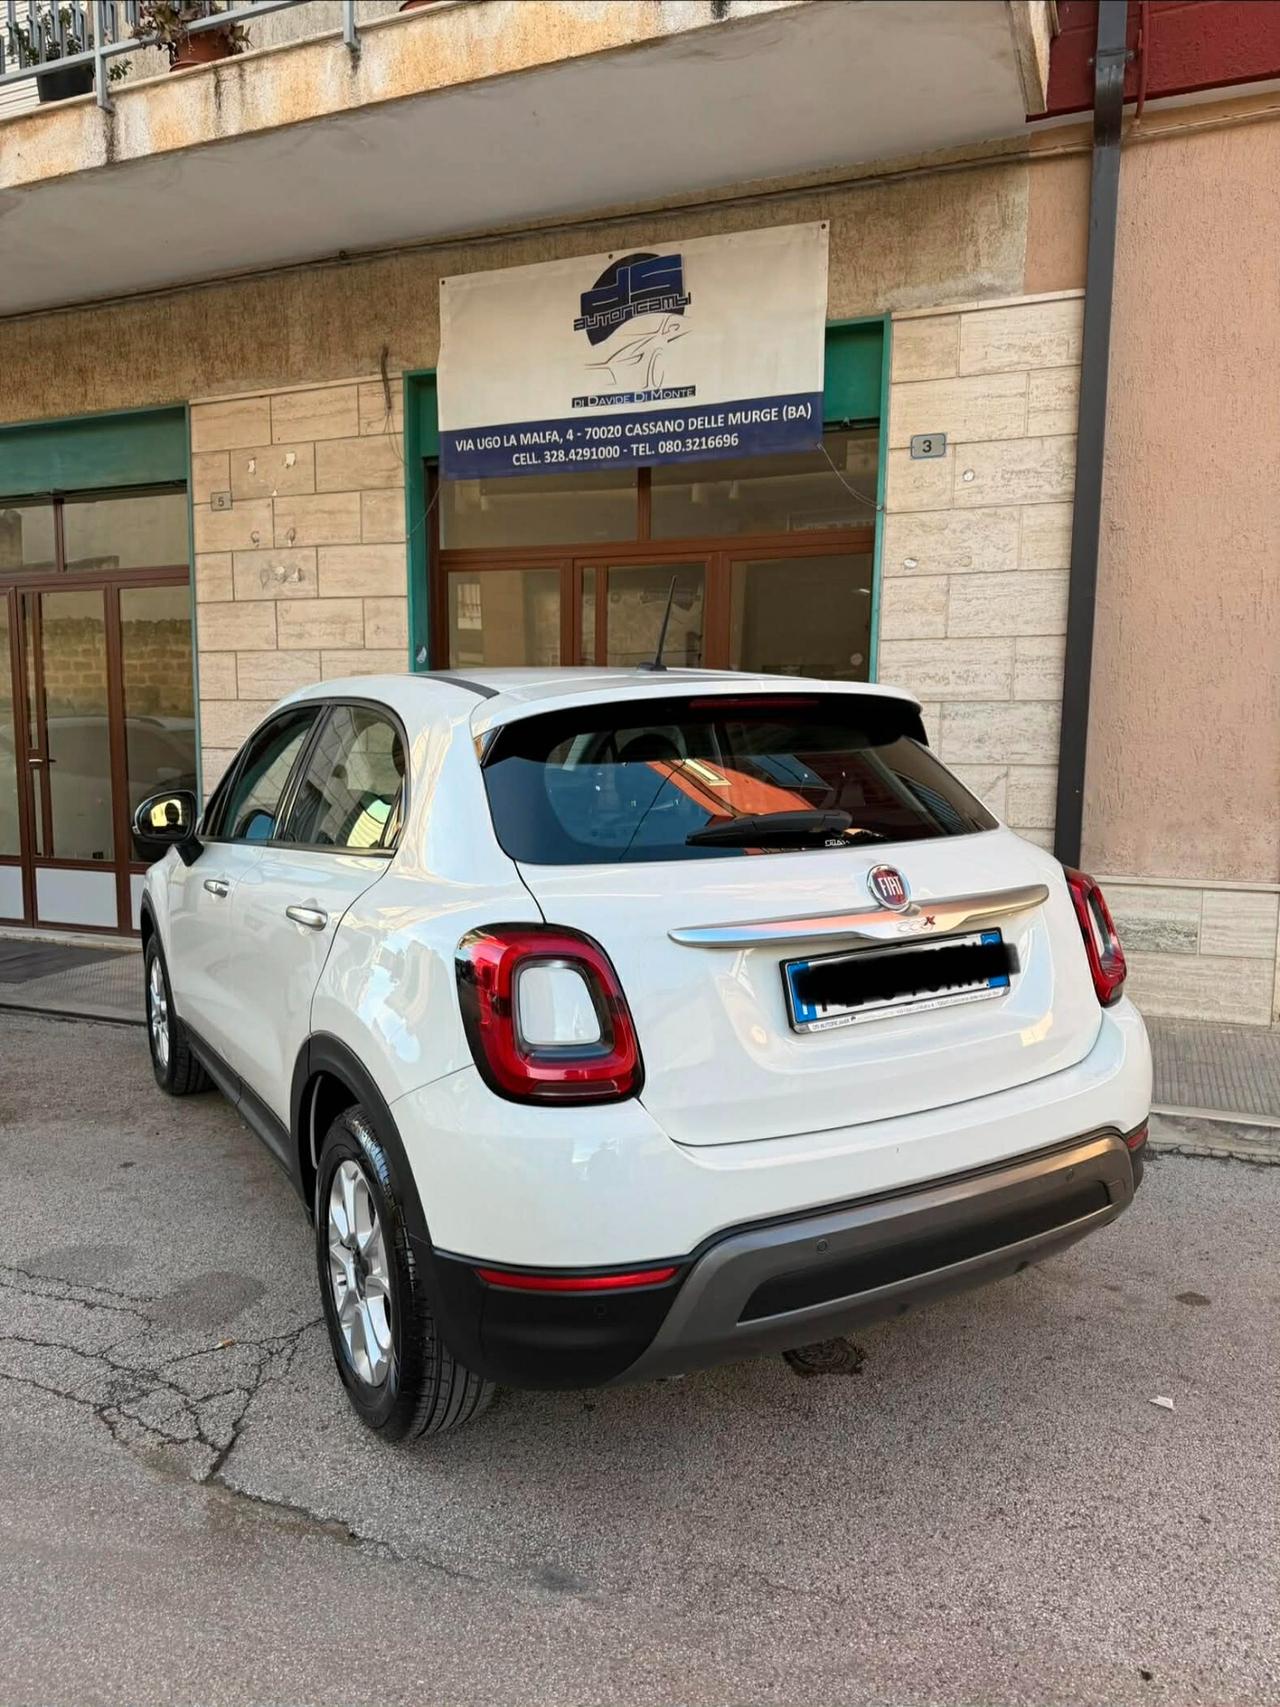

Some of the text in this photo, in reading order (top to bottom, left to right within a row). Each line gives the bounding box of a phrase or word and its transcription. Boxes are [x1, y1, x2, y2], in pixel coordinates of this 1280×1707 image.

[650, 385, 695, 402] MONTE
[455, 439, 475, 453] VIA
[477, 436, 501, 450] UGO
[503, 433, 518, 447] LA
[520, 430, 563, 445] MALFA,
[566, 429, 574, 441] 4
[585, 423, 622, 440] 70020
[625, 418, 685, 436] CASSANO
[688, 413, 725, 431] DELLE
[728, 407, 779, 426] MURGE
[782, 401, 812, 422] (BA)
[512, 453, 541, 466] CELL.
[544, 446, 620, 463] 328.4291000
[631, 443, 655, 456] TEL.
[658, 433, 739, 454] 080.3216696
[922, 439, 932, 453] 3
[218, 496, 225, 507] 5
[877, 875, 904, 897] FIAT
